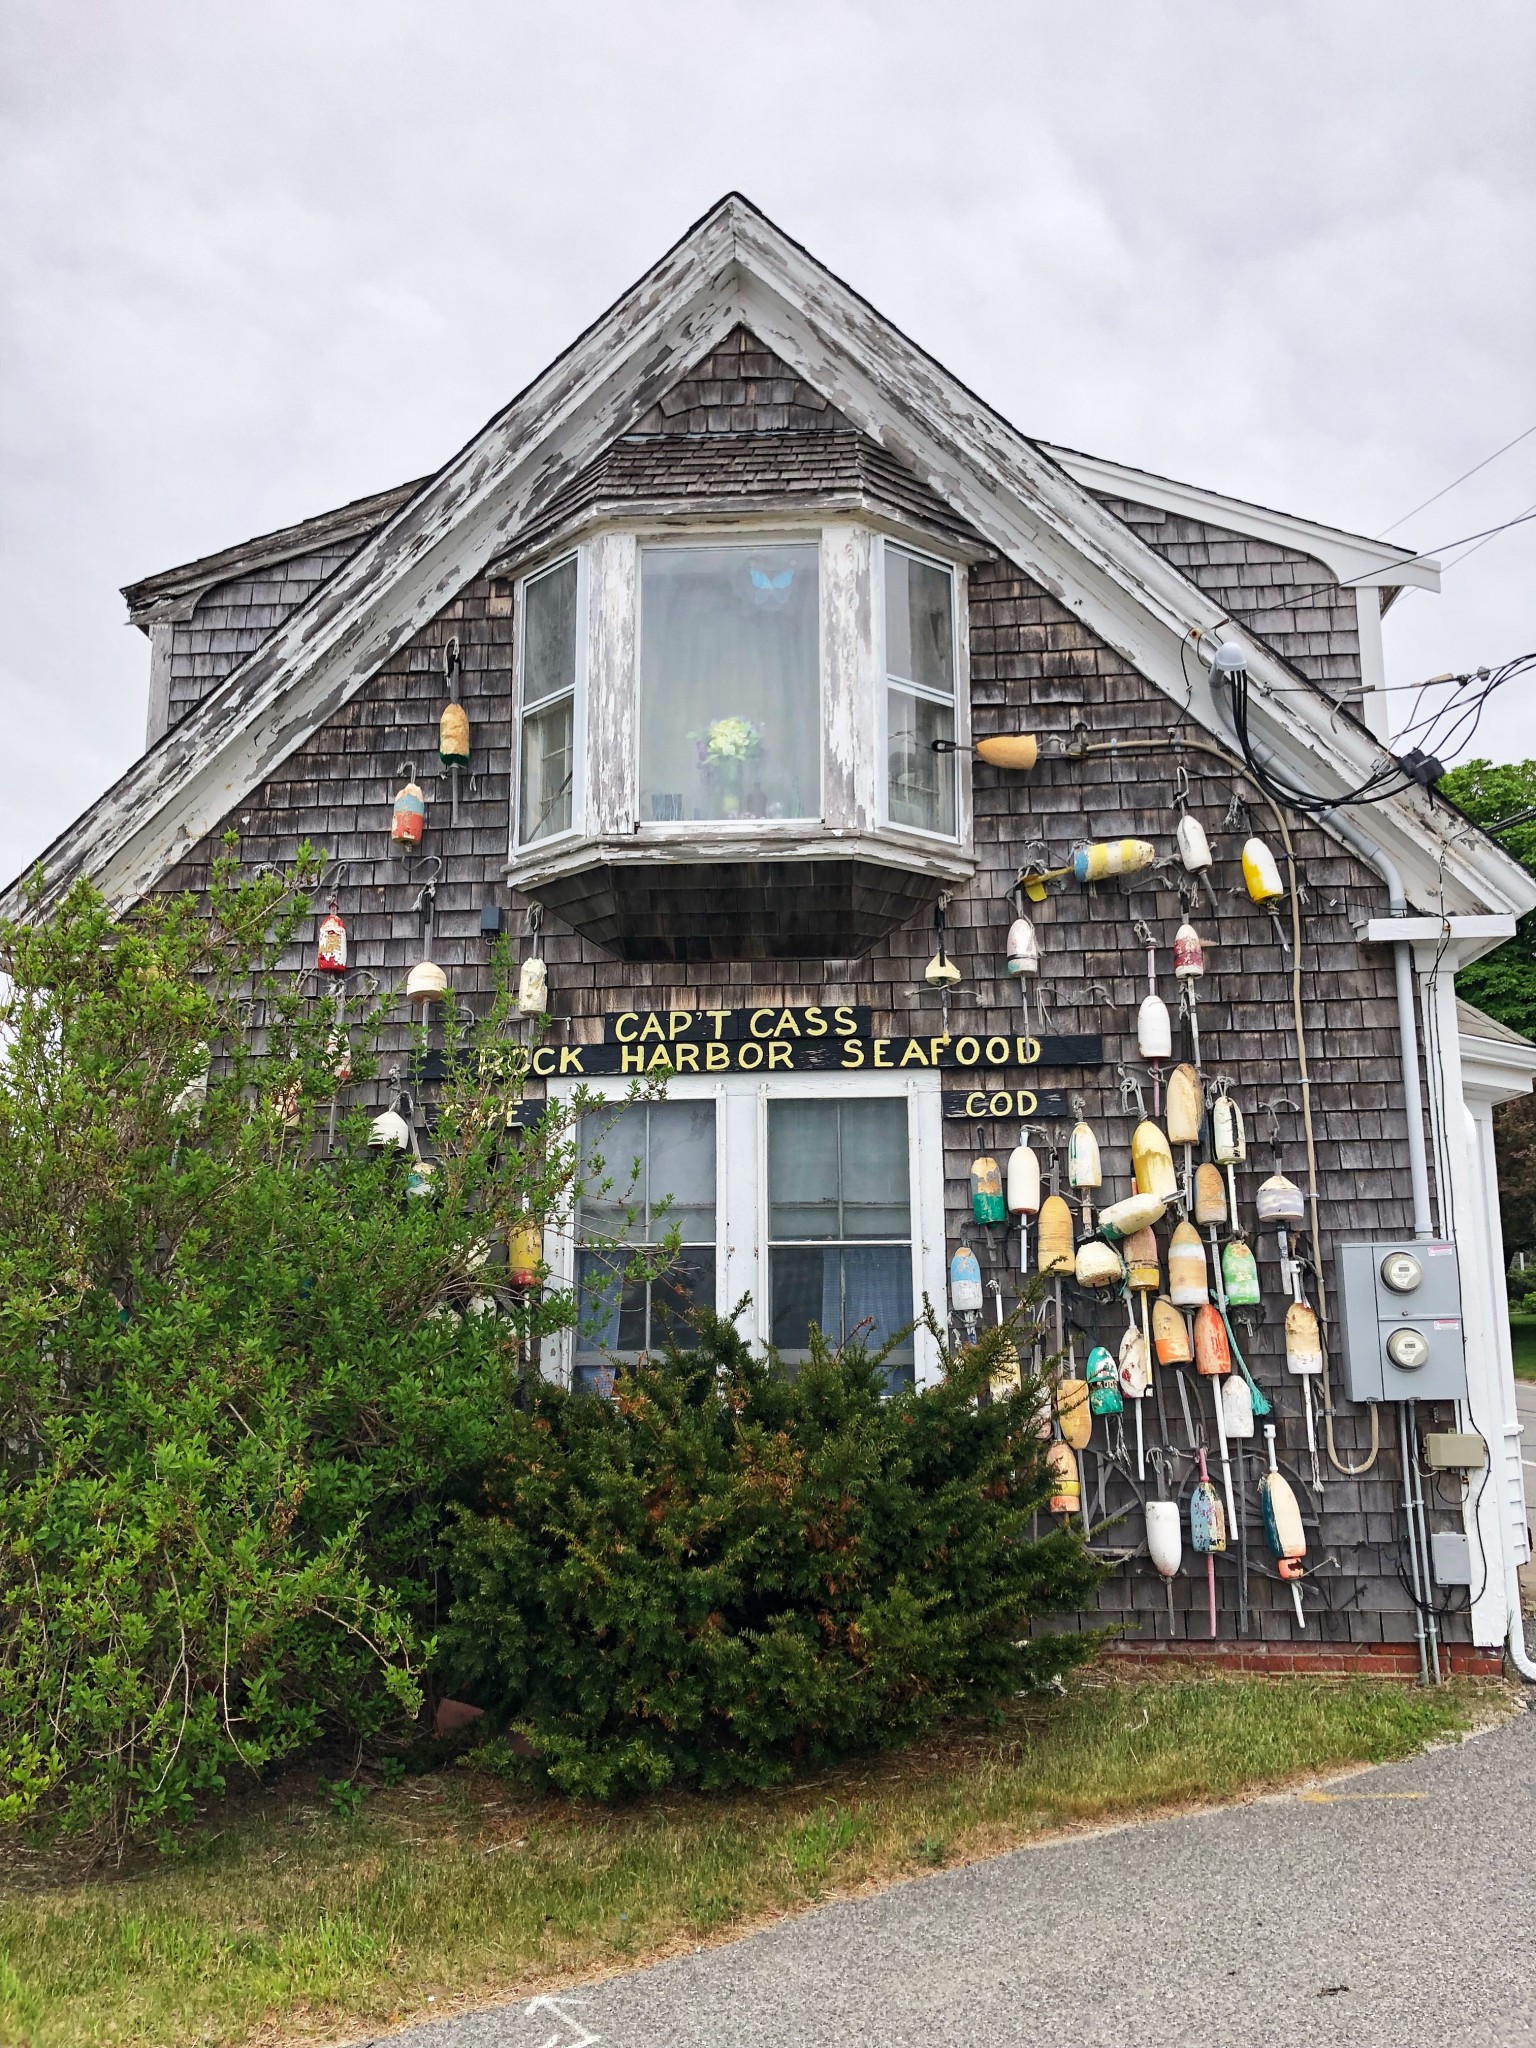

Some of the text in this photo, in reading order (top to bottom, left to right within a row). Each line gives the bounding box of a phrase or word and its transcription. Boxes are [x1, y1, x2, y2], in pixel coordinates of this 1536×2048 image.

[615, 1006, 858, 1043] CAP'T CASS
[620, 1040, 794, 1074] HARBOR
[841, 1037, 1042, 1068] SEAFOOD
[965, 1090, 1038, 1118] COD
